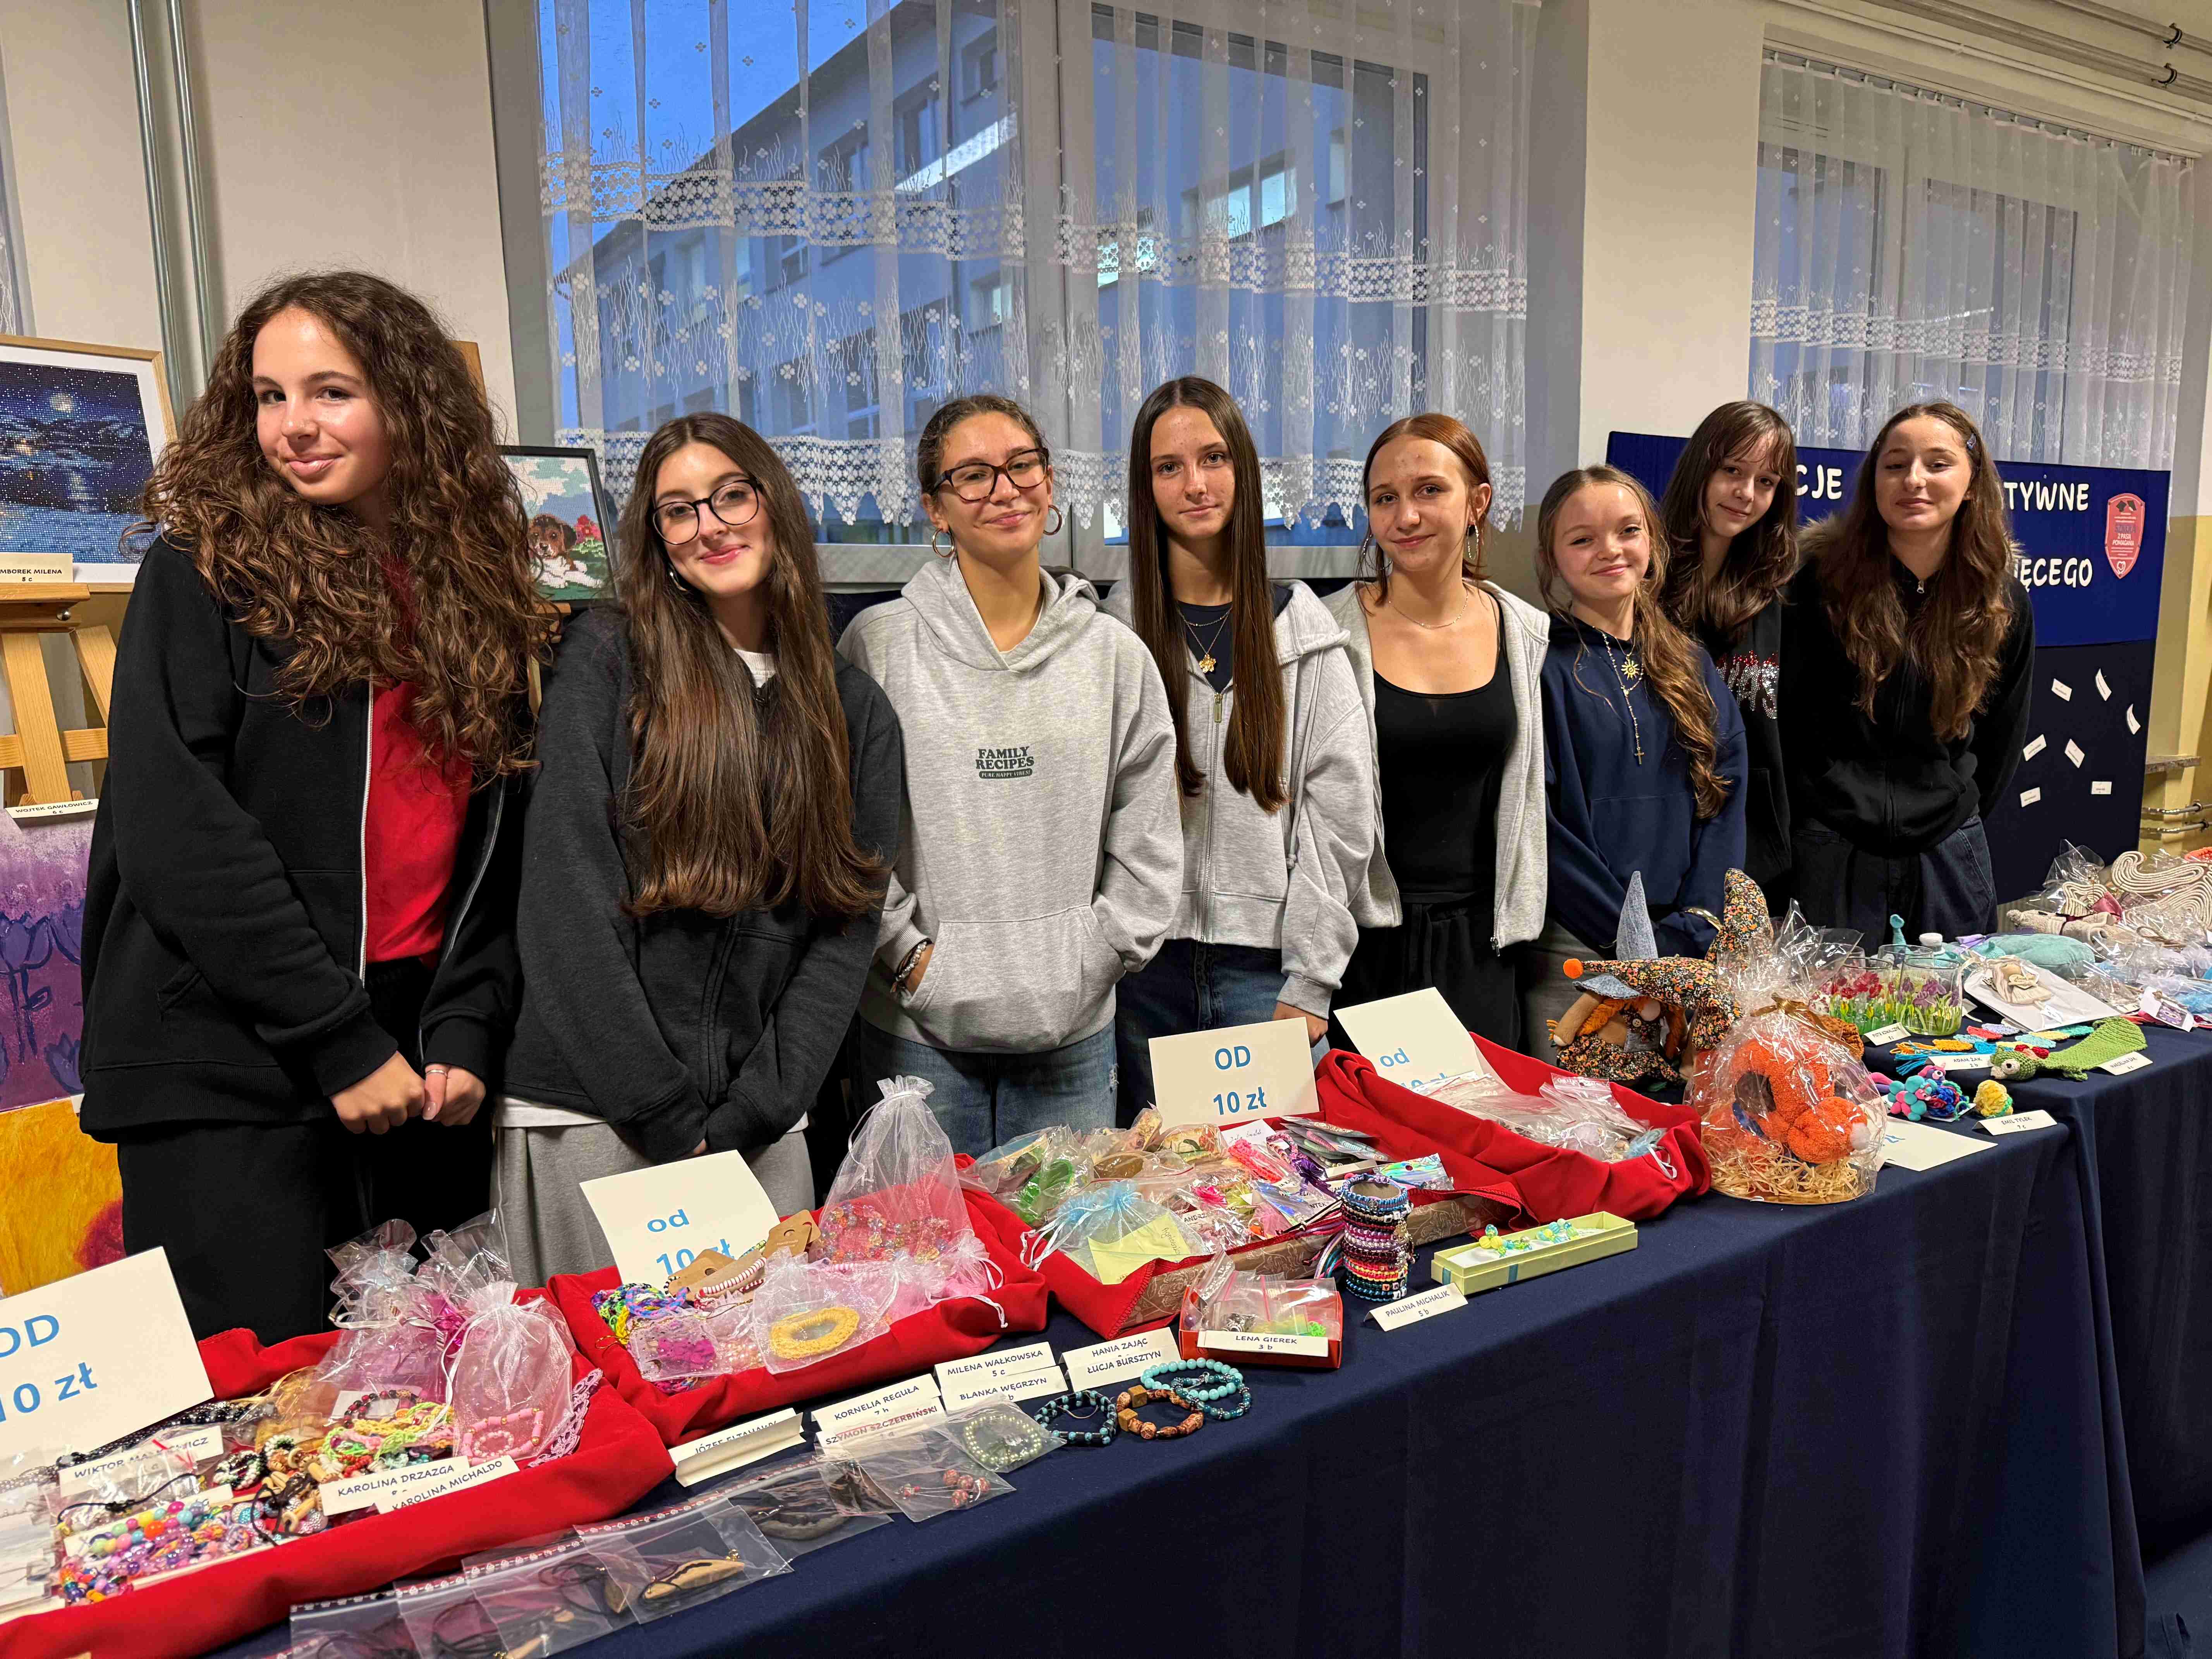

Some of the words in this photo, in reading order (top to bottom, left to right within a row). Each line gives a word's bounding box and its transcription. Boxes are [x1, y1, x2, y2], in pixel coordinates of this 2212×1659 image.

[2004, 481, 2089, 511] TYWNE
[975, 756, 1034, 769] RECIPES
[978, 746, 1029, 759] FAMILY
[47, 801, 93, 810] GAWŁOWICZ
[1215, 1046, 1250, 1070] OD
[1380, 1048, 1410, 1067] od
[1214, 1092, 1239, 1115] 10
[1247, 1087, 1266, 1110] zł
[647, 1209, 689, 1232] od
[656, 1249, 694, 1275] 10
[709, 1238, 735, 1259] ł
[1385, 1303, 1416, 1317] PAULINA
[1416, 1290, 1450, 1307] MICHALIK
[1092, 1345, 1120, 1357] HANIA
[1121, 1338, 1148, 1349] ZAJĄC
[948, 1363, 982, 1375] MILENA
[985, 1350, 1043, 1367] WAŁKOWSKA
[1087, 1362, 1115, 1374] ŁUCJA
[1116, 1350, 1161, 1367] BURSZTYN
[55, 1362, 97, 1401] zł
[960, 1388, 998, 1400] BLANKA
[1000, 1377, 1047, 1392] WĘGRZYN
[834, 1400, 881, 1420] KORNELIA
[883, 1386, 919, 1403] REGUŁA
[826, 1427, 867, 1444] SZYMON
[871, 1406, 938, 1431] SZCZERBIŃSKI
[74, 1460, 124, 1478] WIKTOR
[338, 1478, 397, 1496] KAROLINA
[402, 1465, 454, 1483] DRZAZGA
[450, 1460, 502, 1488] MICHALDO
